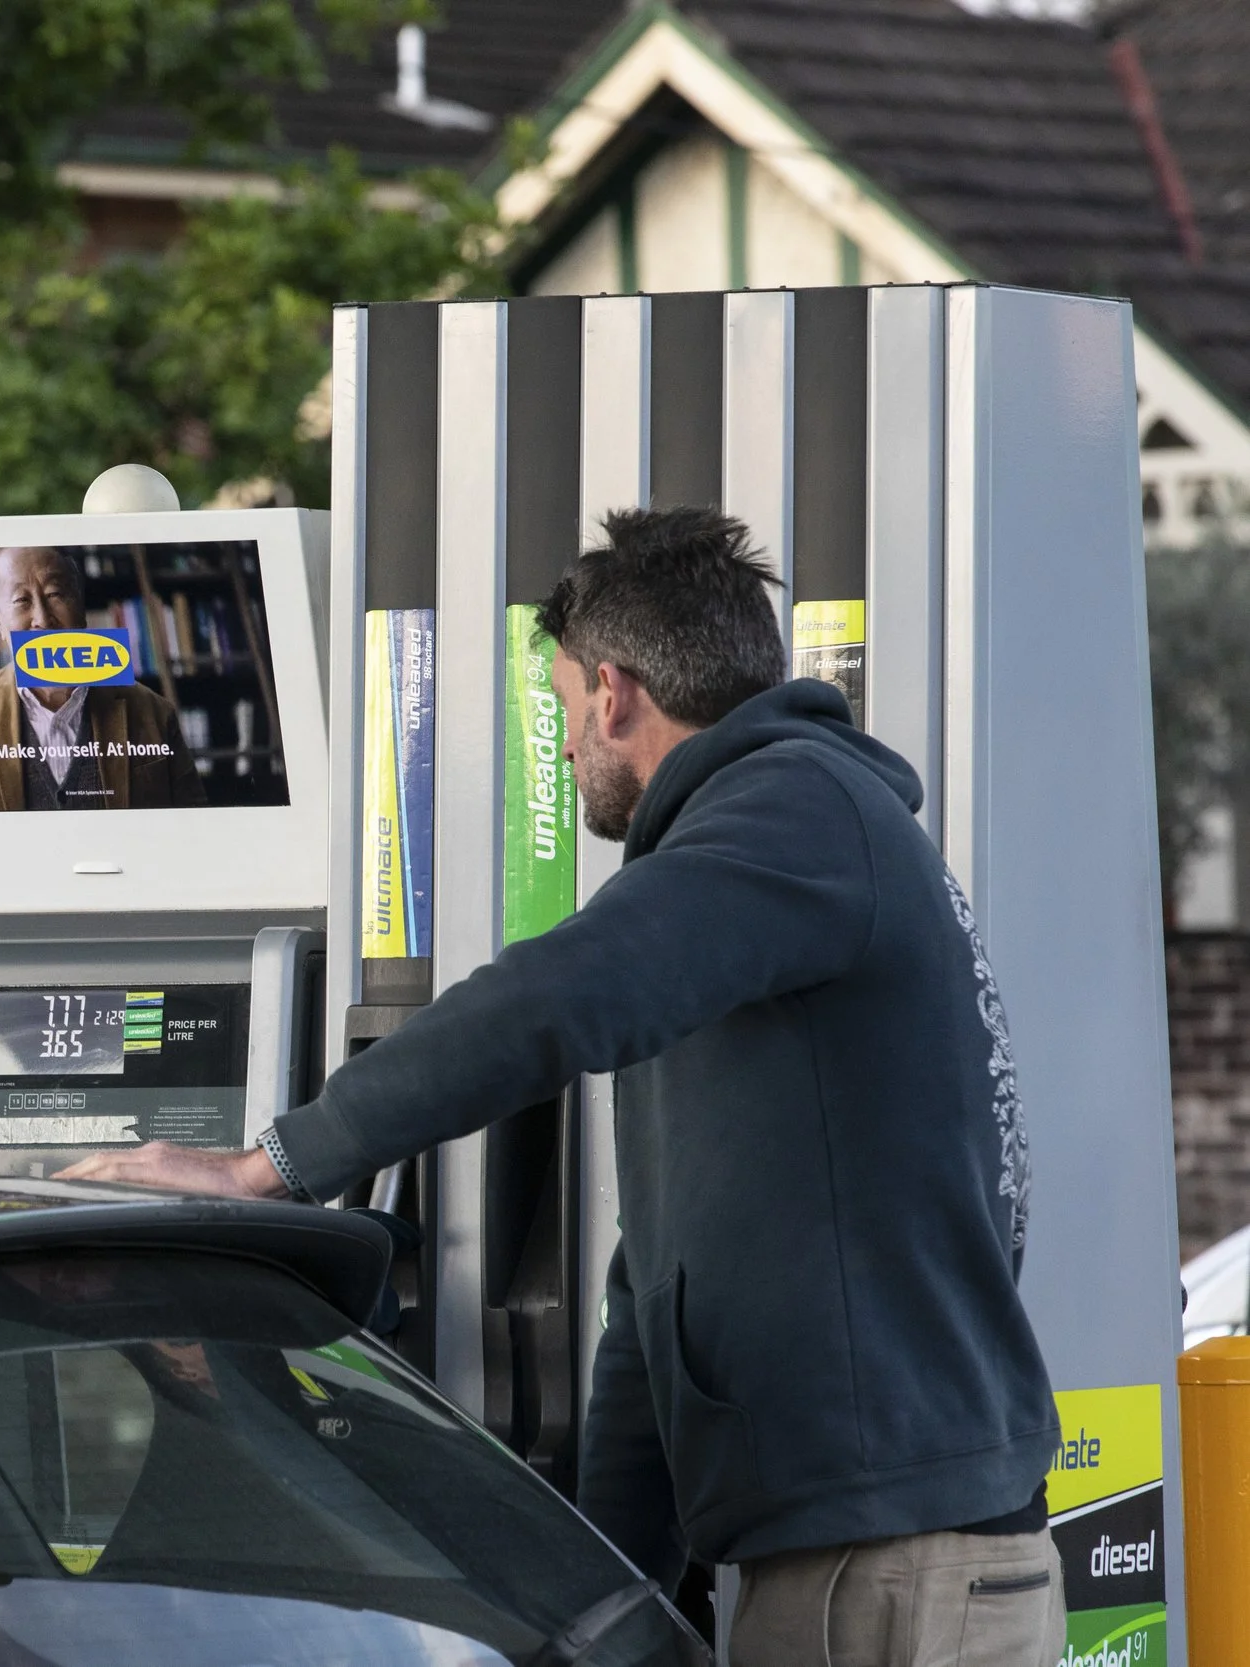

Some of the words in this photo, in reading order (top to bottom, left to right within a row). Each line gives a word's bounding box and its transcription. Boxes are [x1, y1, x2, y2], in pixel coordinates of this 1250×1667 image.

[796, 620, 846, 632] ultimate
[25, 646, 123, 669] IKEA
[425, 630, 433, 664] octane
[424, 666, 432, 680] 98
[527, 653, 546, 682] 94
[816, 657, 862, 669] diesel
[406, 627, 421, 729] unleaded
[38, 741, 104, 762] yourself.
[106, 741, 124, 757] At
[127, 740, 175, 756] home.
[528, 690, 557, 861] unleaded
[561, 761, 571, 780] 10%
[562, 781, 571, 792] to
[563, 793, 572, 807] up
[562, 808, 570, 829] with
[377, 816, 392, 936] ultimate
[168, 1020, 196, 1029] PRICE
[198, 1020, 217, 1029] PER
[39, 1029, 83, 1058] 3.65
[167, 1032, 194, 1041] LITRE
[1090, 1530, 1155, 1578] diesel
[1133, 1631, 1148, 1661] 91
